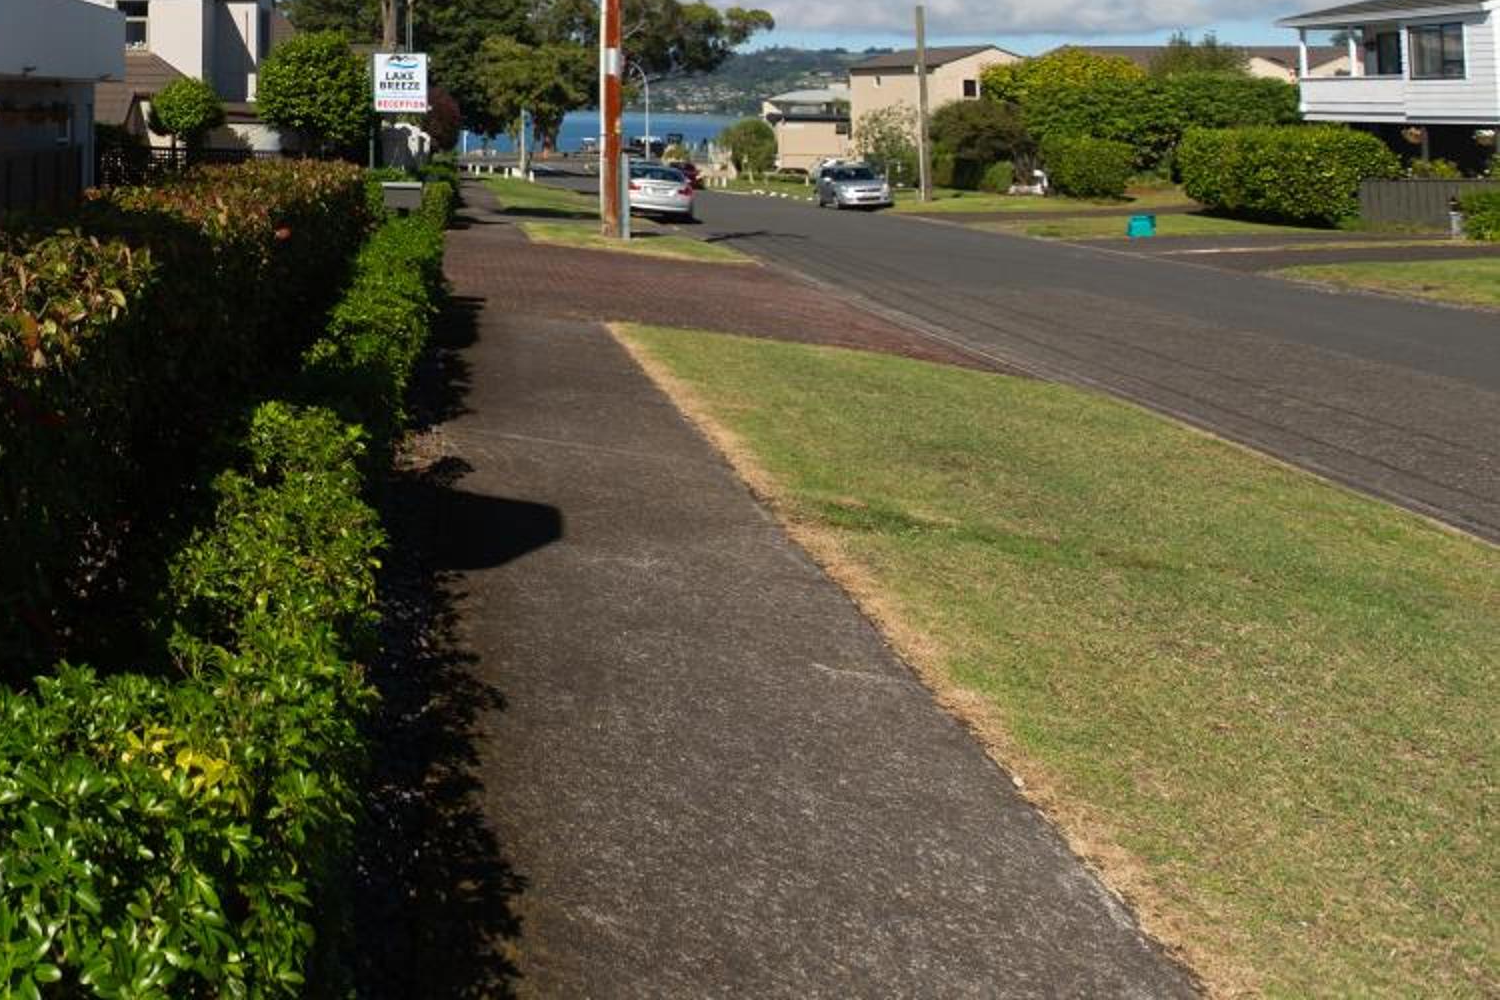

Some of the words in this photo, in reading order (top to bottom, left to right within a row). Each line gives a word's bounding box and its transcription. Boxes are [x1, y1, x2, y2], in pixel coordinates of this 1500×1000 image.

[385, 72, 414, 80] LAKE
[379, 82, 420, 90] BREEZE
[378, 100, 425, 108] RECEPTION
